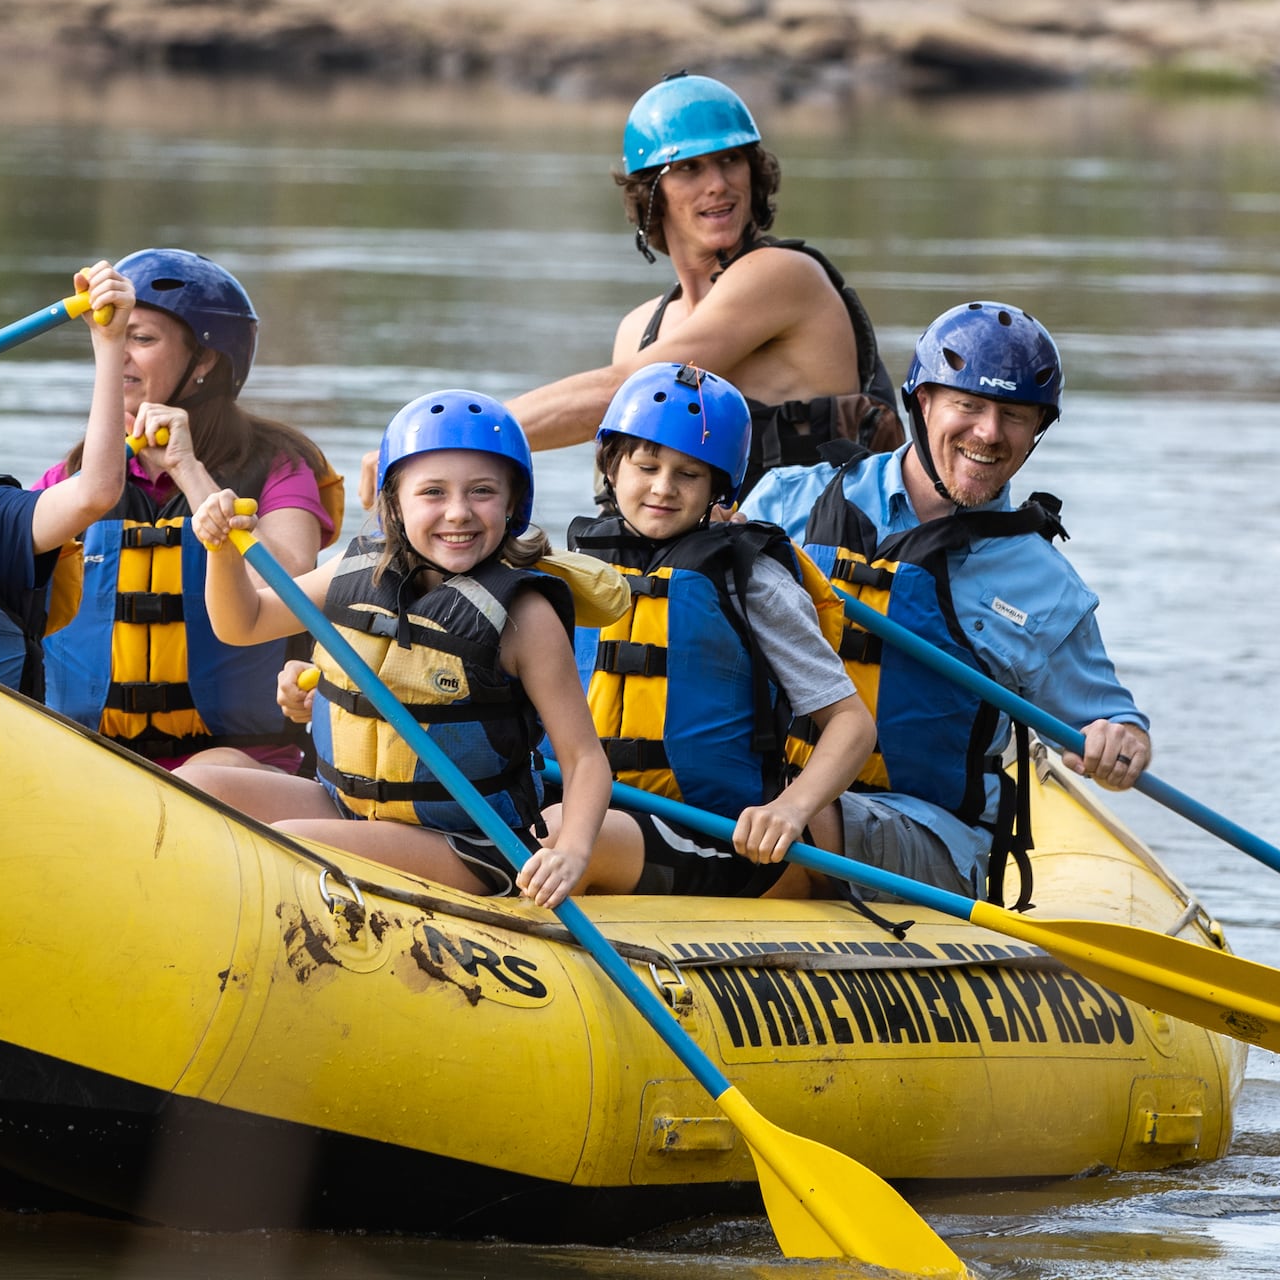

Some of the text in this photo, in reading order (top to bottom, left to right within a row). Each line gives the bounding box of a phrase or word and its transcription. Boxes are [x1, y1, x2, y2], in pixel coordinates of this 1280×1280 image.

[980, 376, 1017, 391] NRS
[423, 925, 548, 999] NRS
[670, 942, 1135, 1048] WHITEWATER EXPRESS
